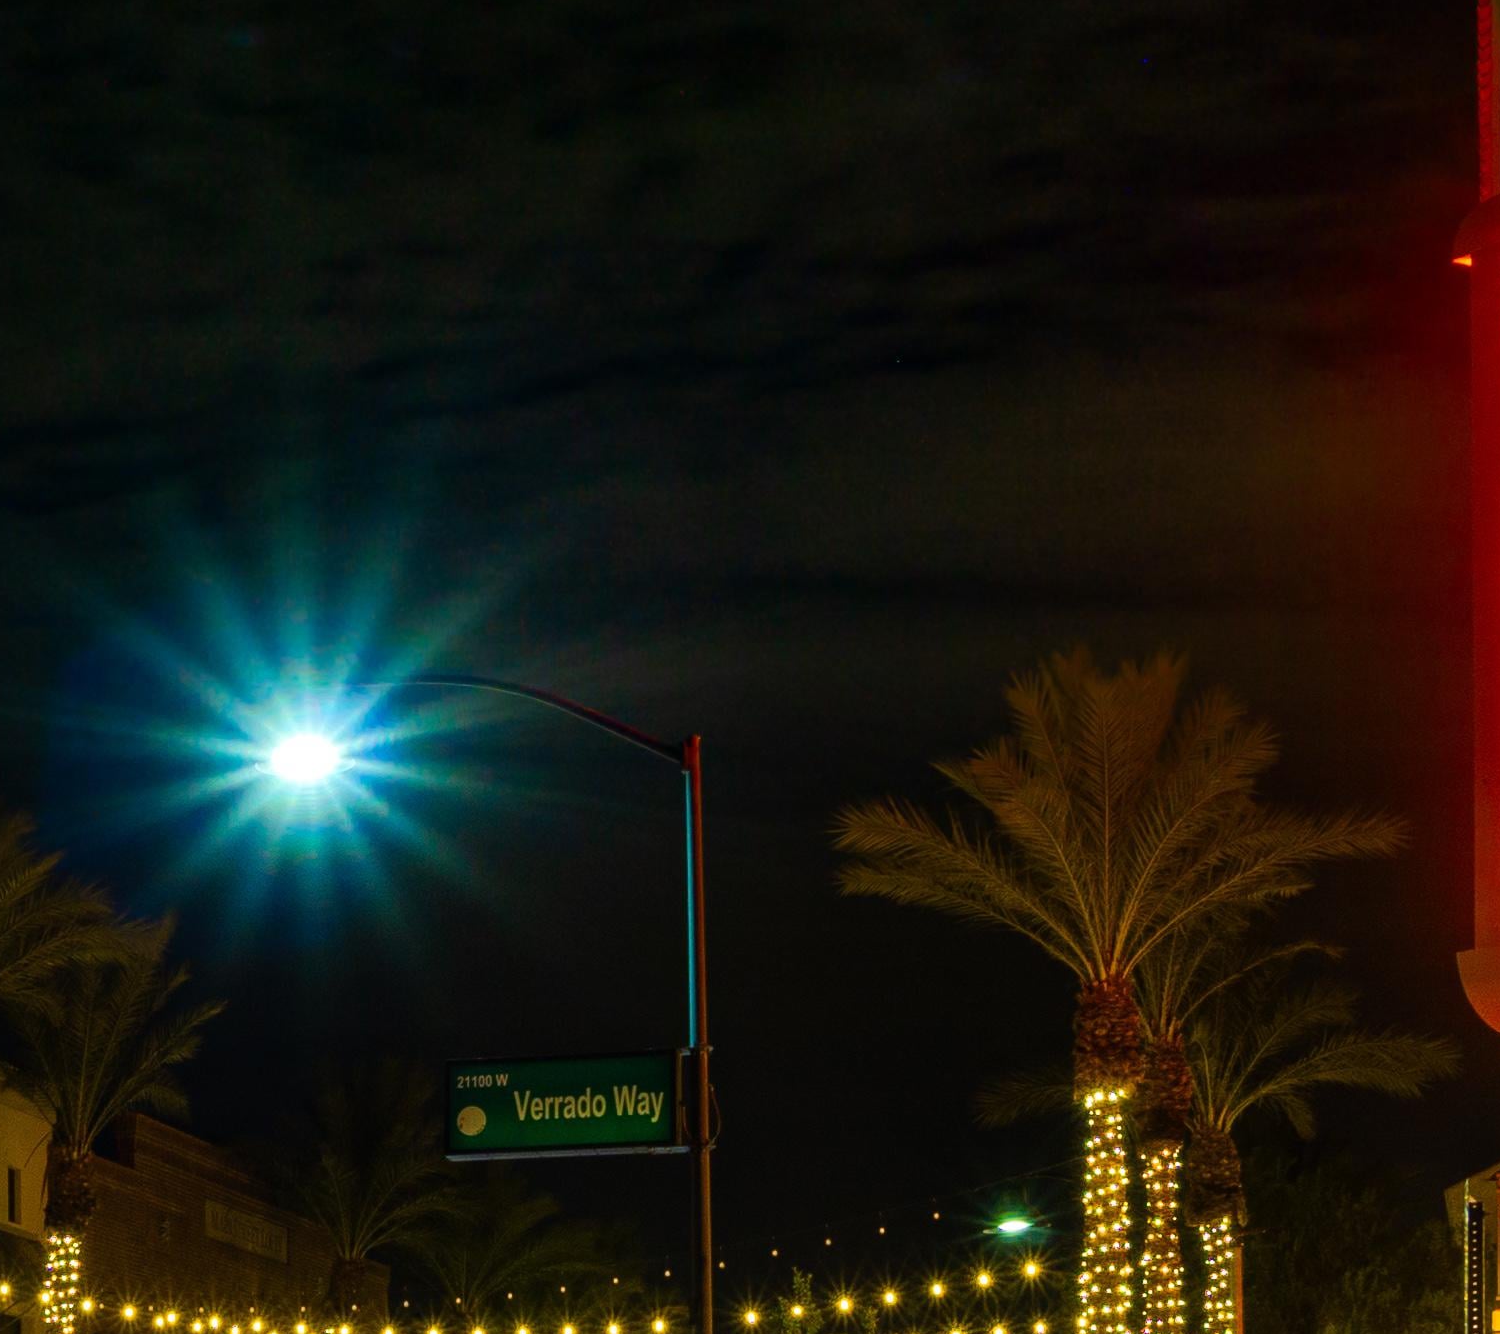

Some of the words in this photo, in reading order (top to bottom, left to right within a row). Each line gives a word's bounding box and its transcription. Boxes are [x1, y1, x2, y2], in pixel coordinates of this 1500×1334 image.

[457, 1074, 492, 1089] 21100
[496, 1073, 508, 1086] W
[513, 1087, 606, 1121] Verrado
[613, 1084, 664, 1123] Way
